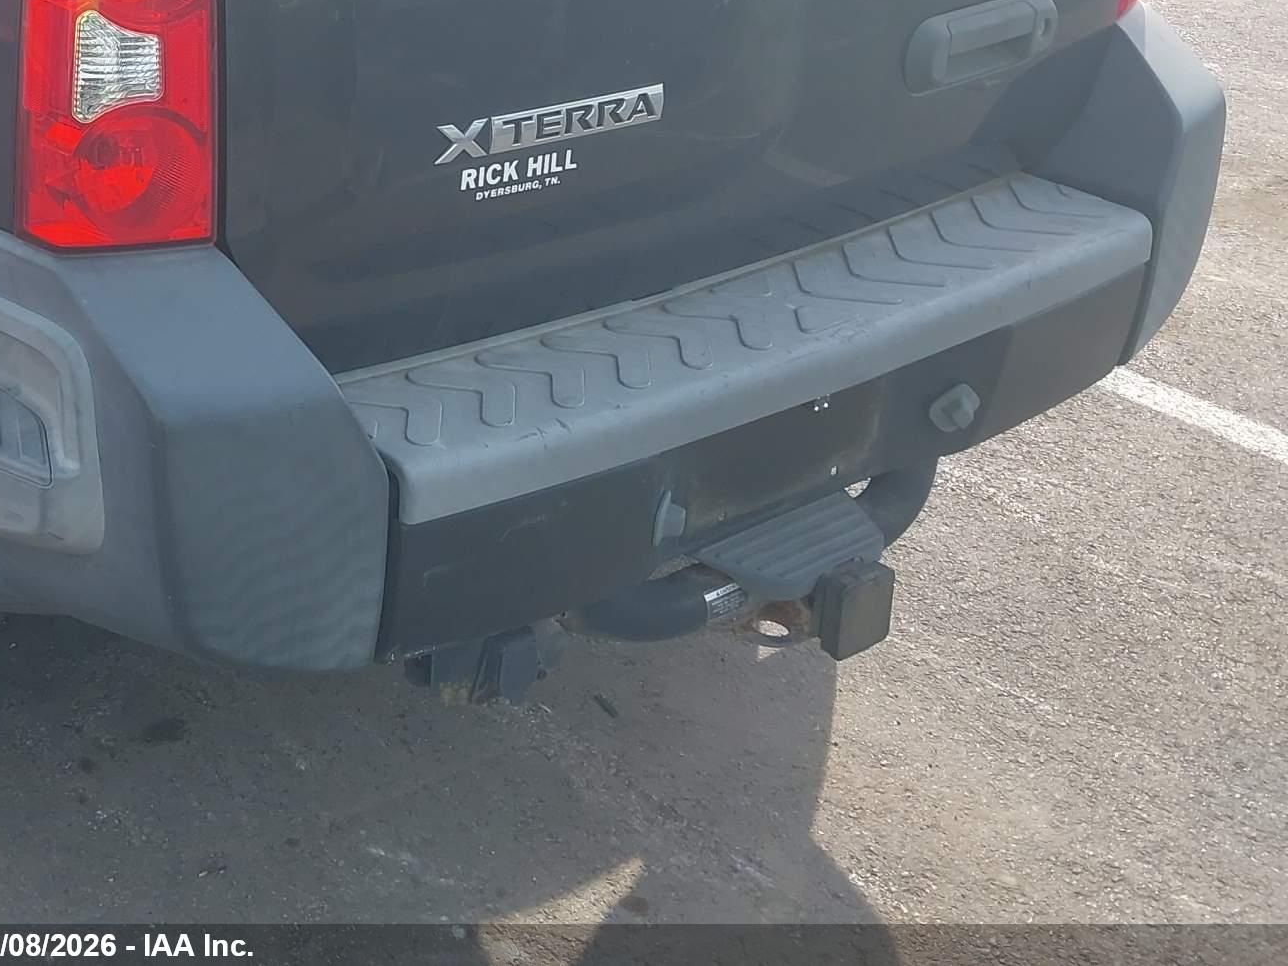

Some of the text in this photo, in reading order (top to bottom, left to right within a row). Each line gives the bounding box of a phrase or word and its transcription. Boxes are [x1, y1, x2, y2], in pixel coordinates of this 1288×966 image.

[459, 149, 578, 191] RICK HILL
[475, 175, 561, 202] DYERSBURG, TN.
